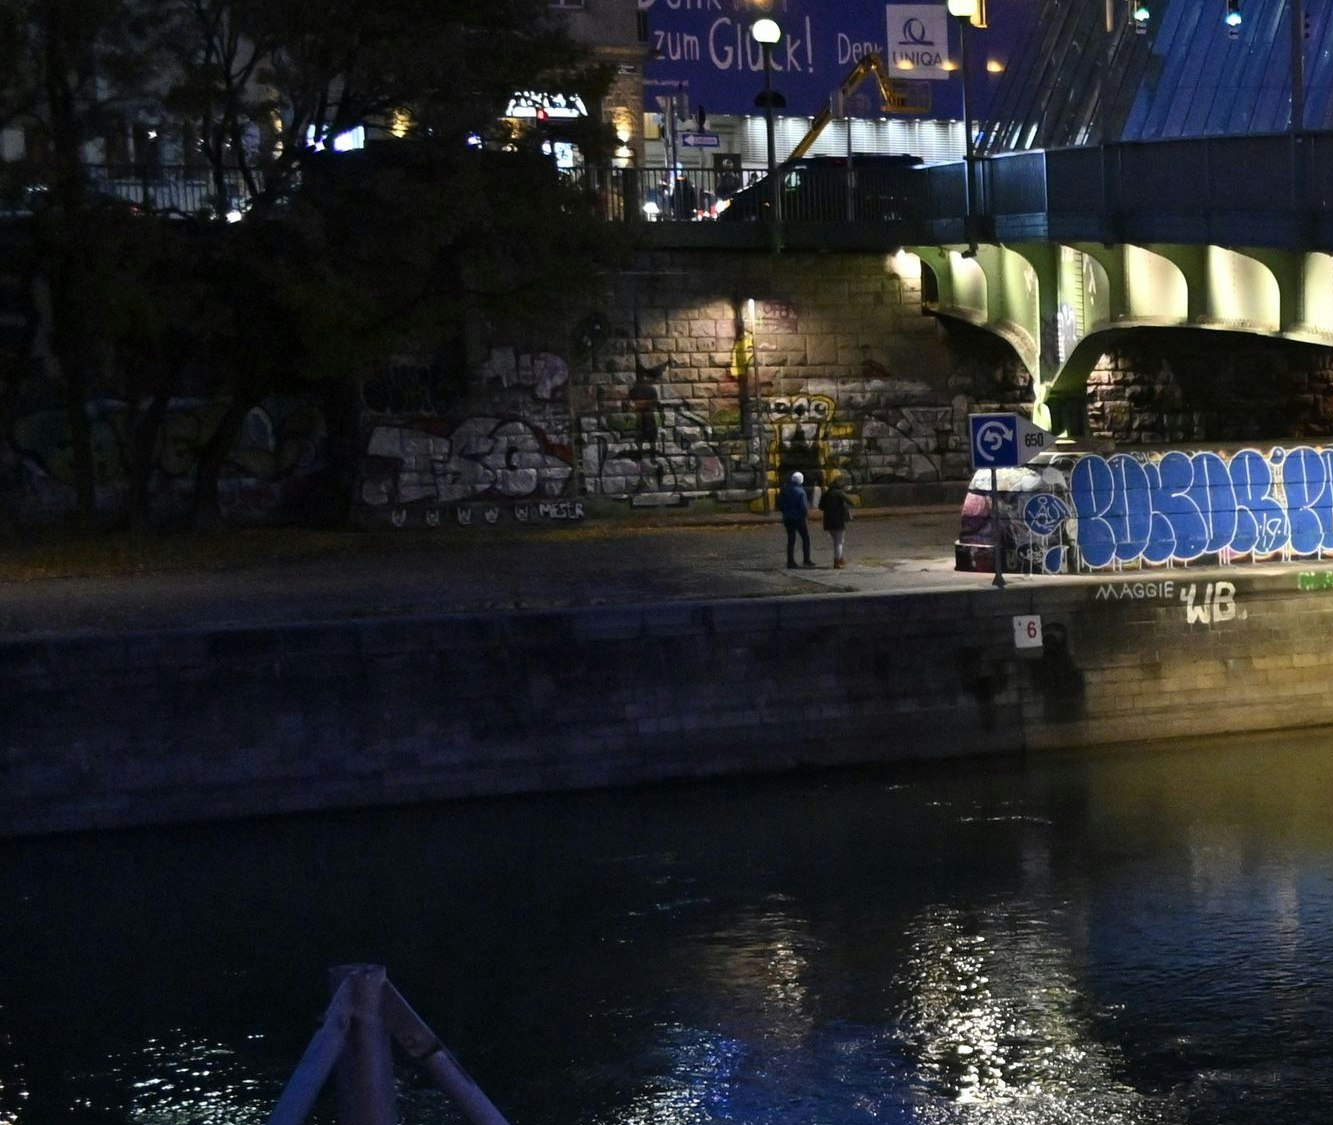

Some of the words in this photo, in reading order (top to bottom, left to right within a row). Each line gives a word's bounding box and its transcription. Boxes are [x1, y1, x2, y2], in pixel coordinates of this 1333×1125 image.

[653, 30, 700, 61] zum
[893, 51, 943, 67] UNIQA
[1024, 431, 1044, 448] 650
[1096, 580, 1175, 601] MAGGIE
[1027, 620, 1037, 638] 6
